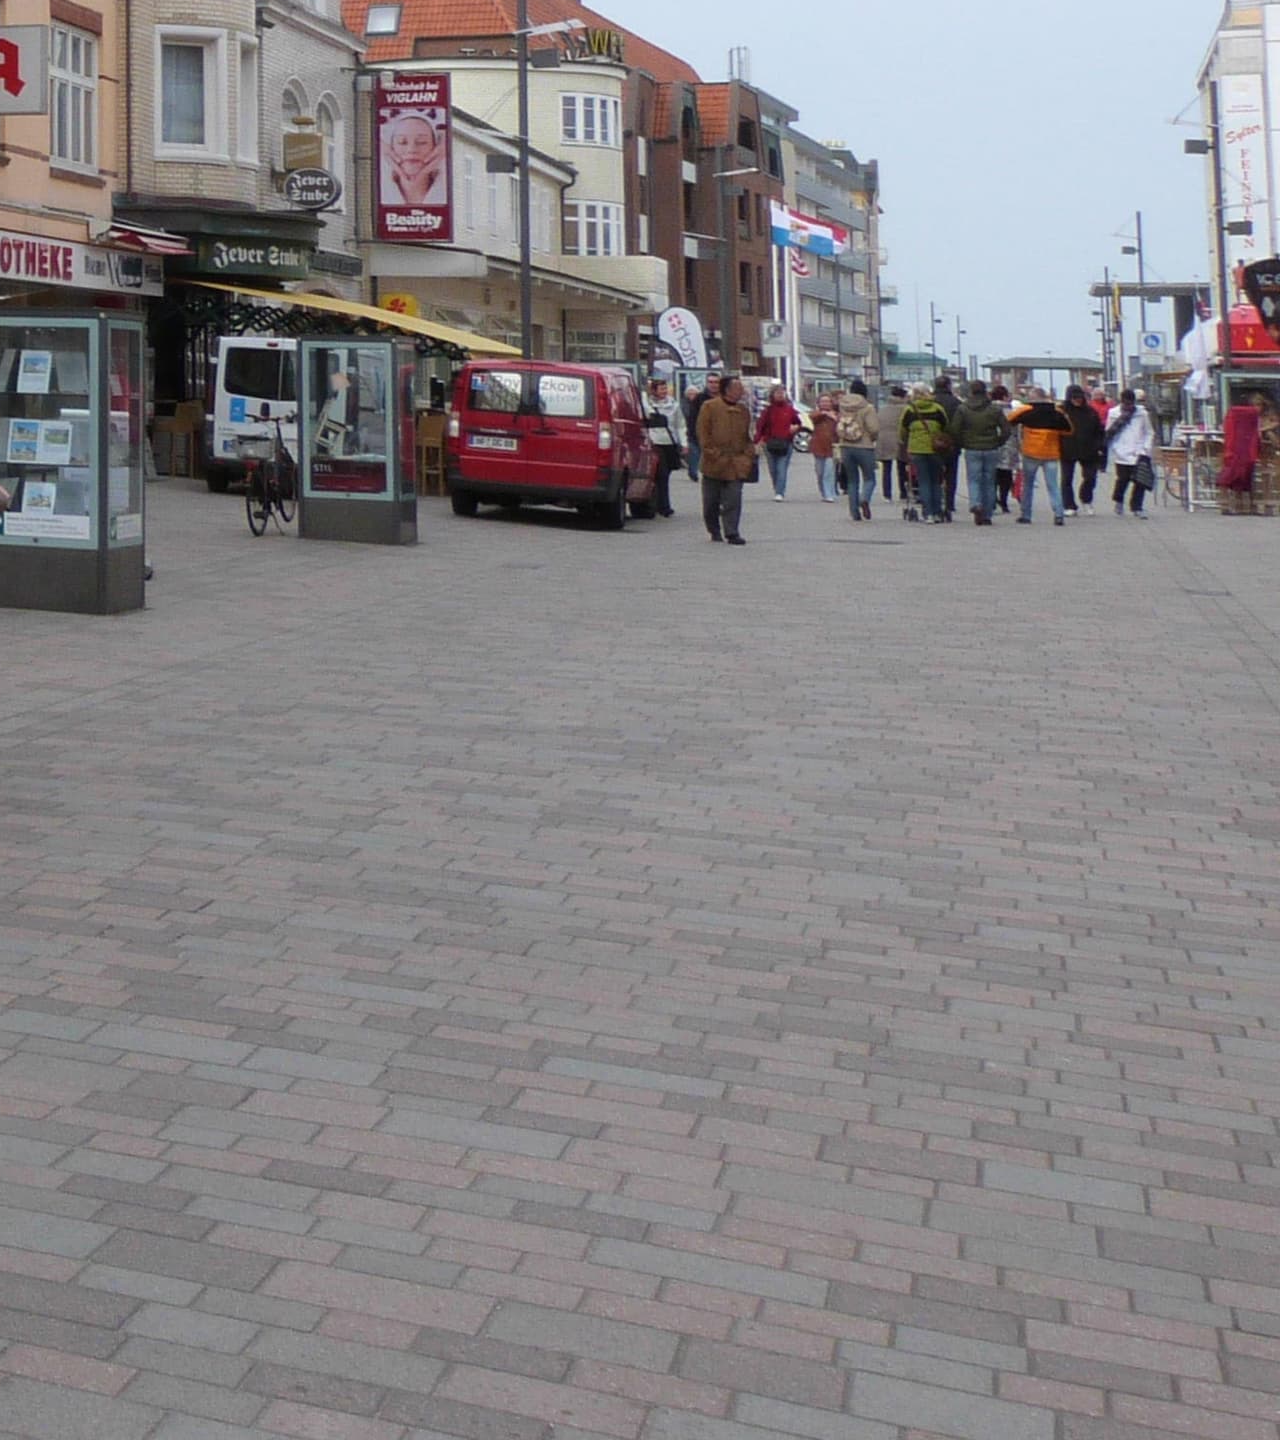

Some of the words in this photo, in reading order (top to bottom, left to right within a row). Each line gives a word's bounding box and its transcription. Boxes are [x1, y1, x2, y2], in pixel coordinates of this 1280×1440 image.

[386, 91, 438, 104] VIGLAHN
[385, 213, 443, 229] Beauty
[212, 241, 266, 269] Jever
